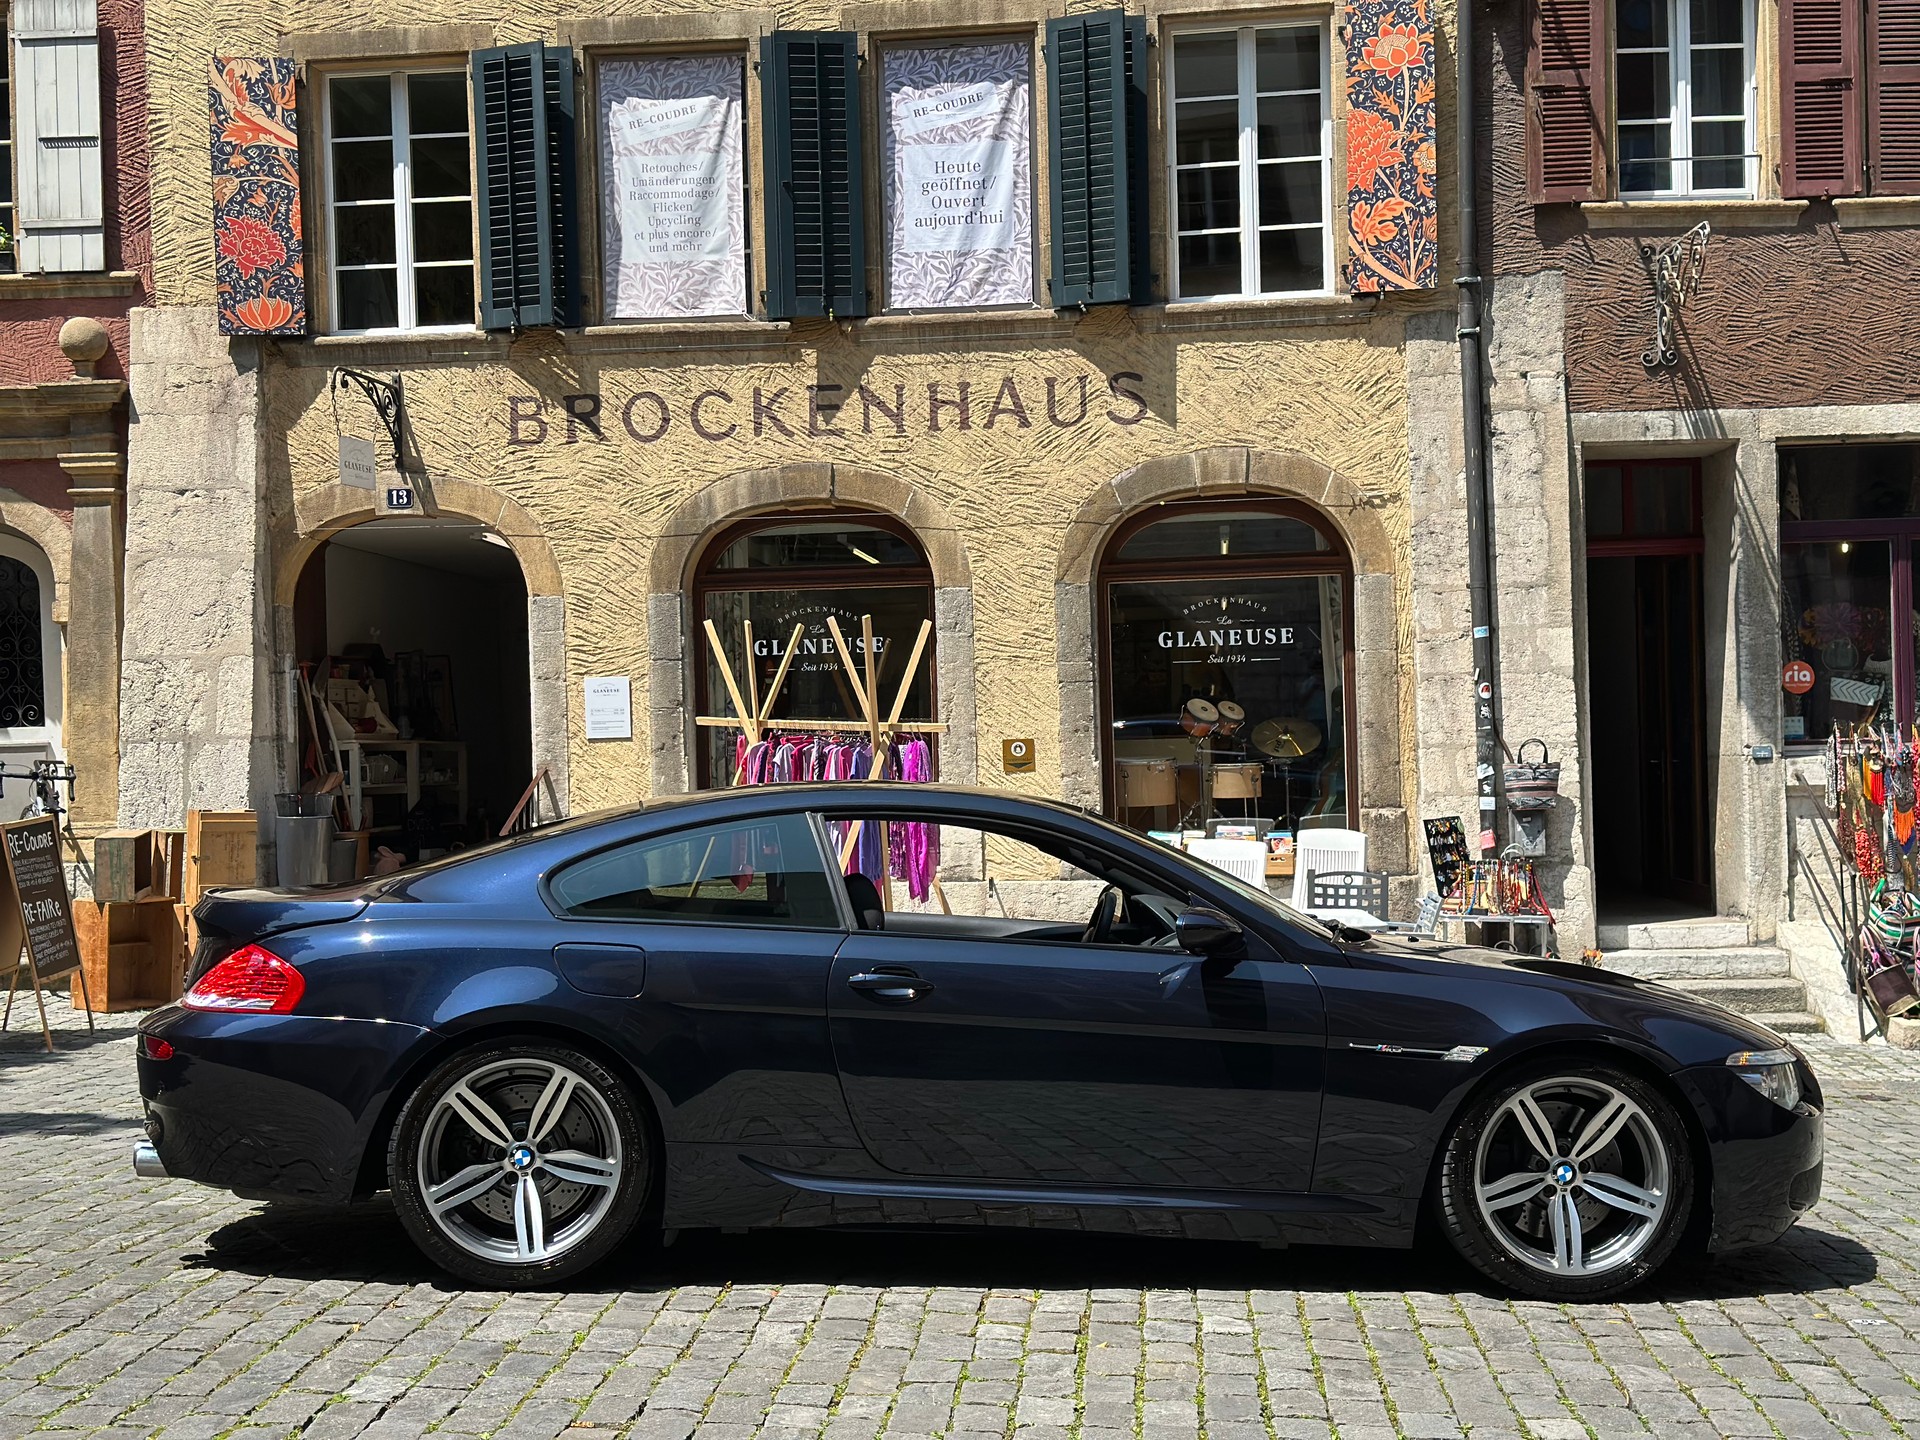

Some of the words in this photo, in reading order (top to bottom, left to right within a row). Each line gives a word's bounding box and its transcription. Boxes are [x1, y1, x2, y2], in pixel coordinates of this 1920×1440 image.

[913, 92, 984, 118] RE-COUDRE
[629, 105, 697, 130] RE-COUDRE
[641, 161, 704, 173] Retouches/
[934, 161, 981, 174] Heute
[632, 175, 715, 188] Umänderungen
[921, 176, 997, 196] geöffnet/
[629, 188, 720, 200] Raccommodage/
[653, 202, 693, 213] Flicken
[931, 195, 986, 209] Ouvert
[648, 215, 702, 228] Upcycling
[634, 231, 645, 240] et
[649, 229, 670, 242] plus
[673, 227, 717, 239] encore/
[649, 242, 668, 253] und
[672, 241, 702, 251] mehr
[507, 371, 1150, 447] BROCKENHAUS
[391, 490, 408, 504] 13
[778, 606, 858, 624] BROCKENHAUS
[1158, 628, 1294, 648] GLANEUSE
[1207, 654, 1225, 664] Seit
[1226, 654, 1246, 663] 1934
[801, 662, 818, 671] Seit
[819, 662, 838, 671] 1934
[1785, 665, 1810, 682] ria
